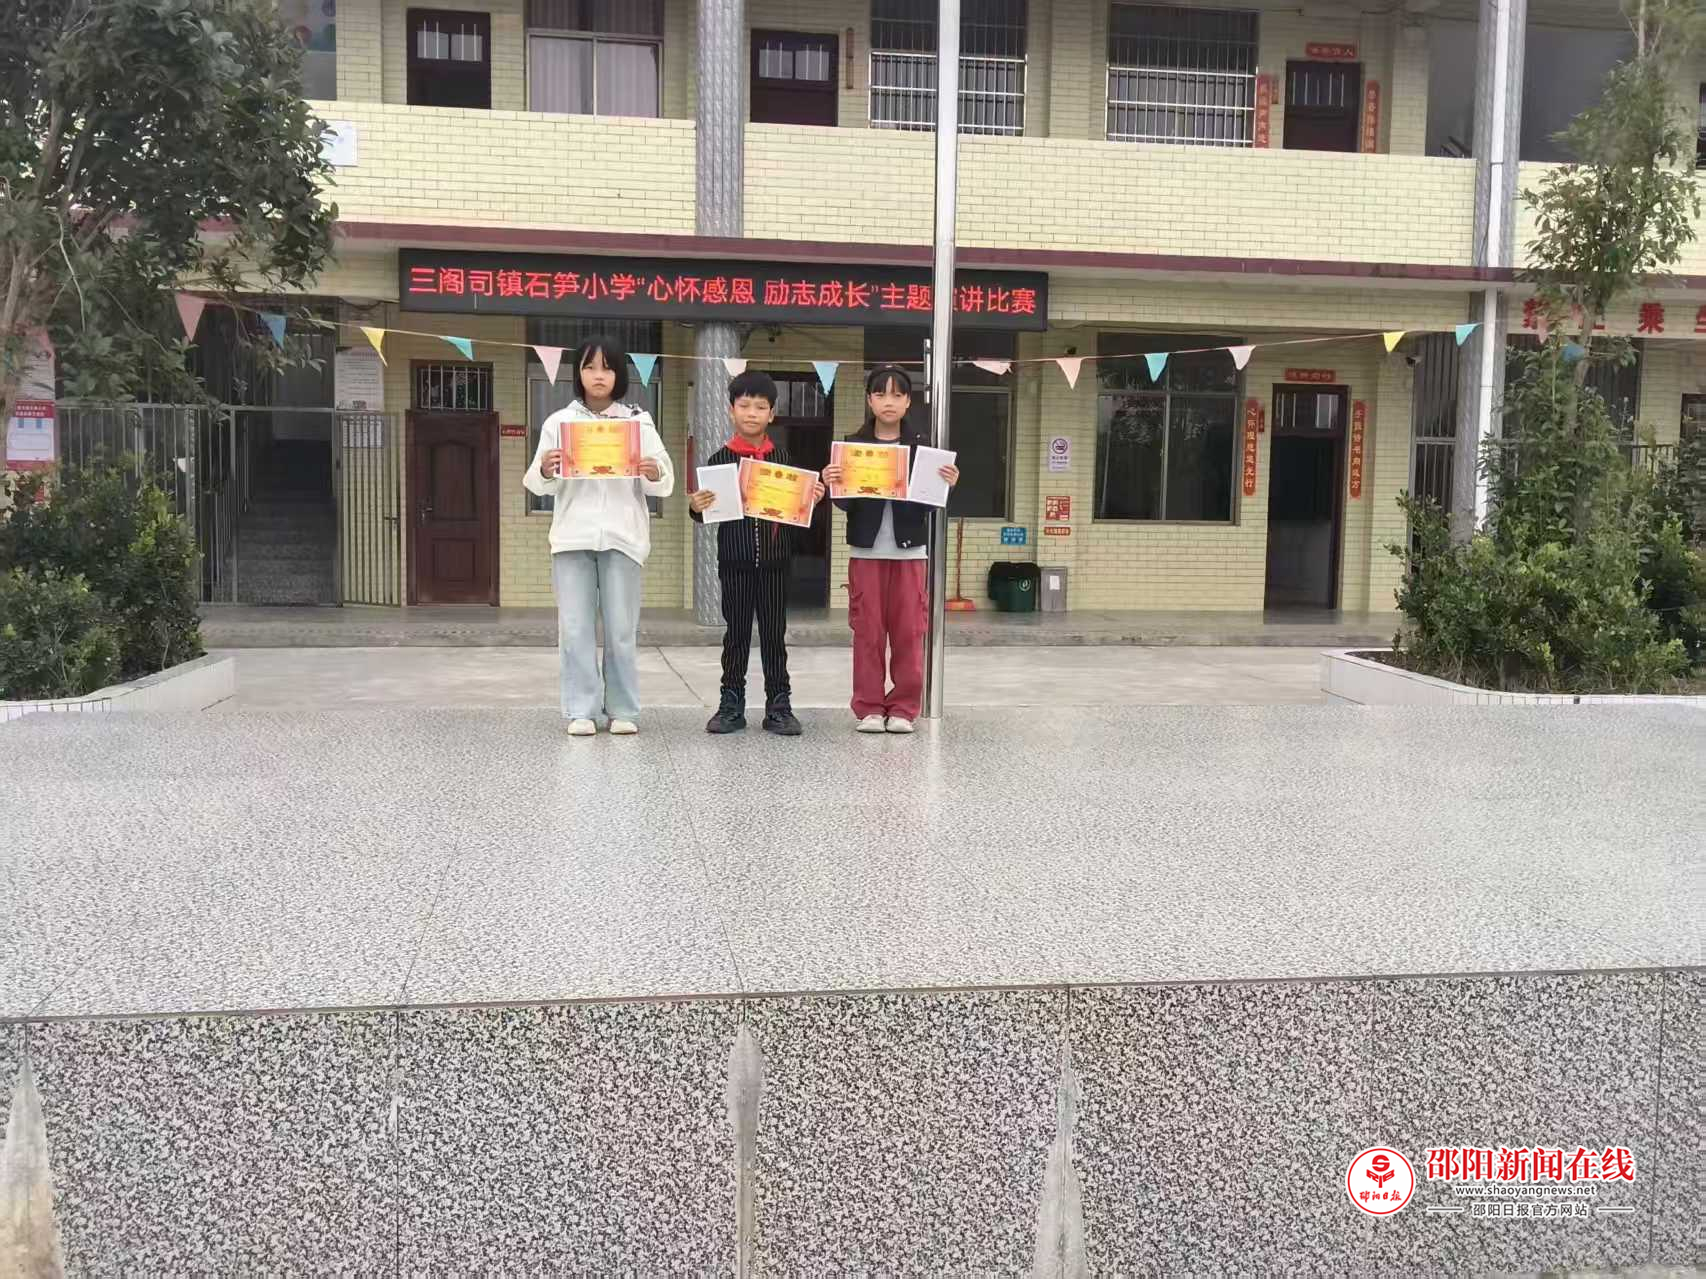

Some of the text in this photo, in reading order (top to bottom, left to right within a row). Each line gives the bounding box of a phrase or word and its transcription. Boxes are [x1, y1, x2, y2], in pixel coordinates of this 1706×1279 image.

[763, 277, 1036, 315] 励志成长”主题讲比赛
